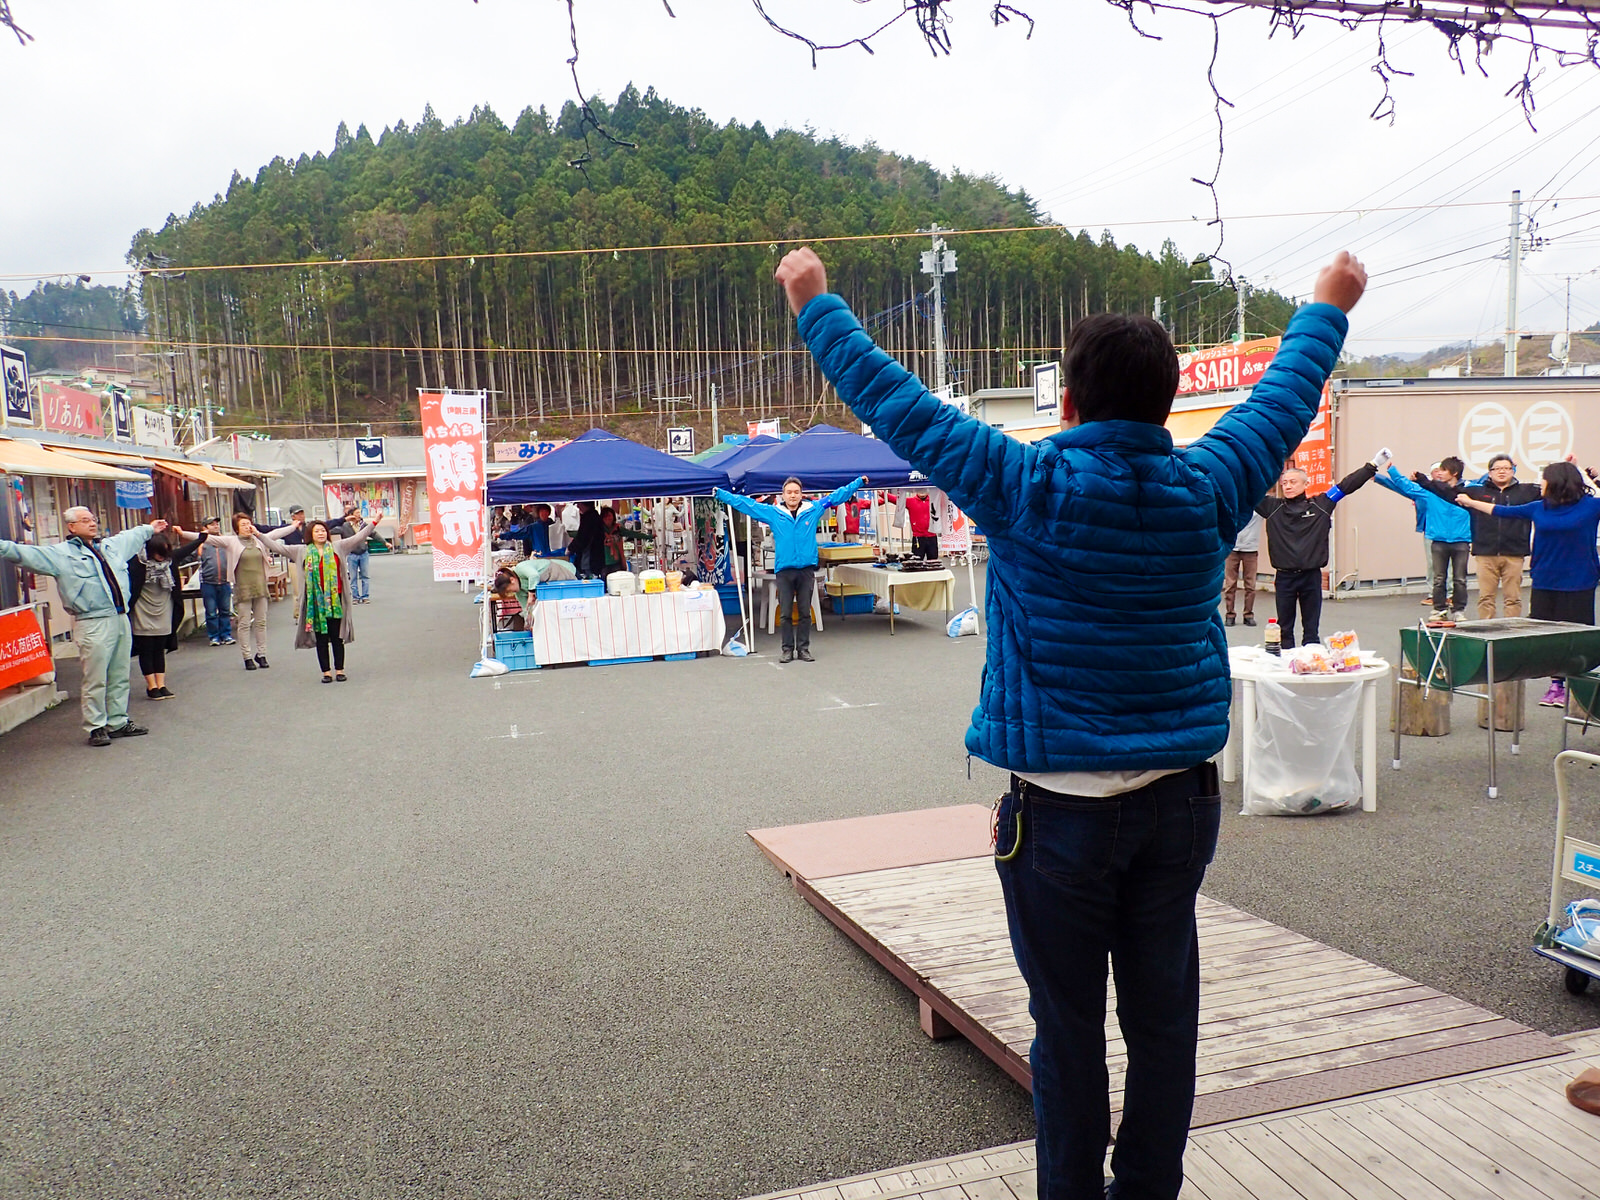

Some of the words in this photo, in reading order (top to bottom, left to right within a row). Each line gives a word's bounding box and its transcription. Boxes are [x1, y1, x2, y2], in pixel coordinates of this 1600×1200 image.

[1195, 356, 1239, 390] SARI
[49, 397, 84, 429] りあん
[519, 442, 565, 458] みな
